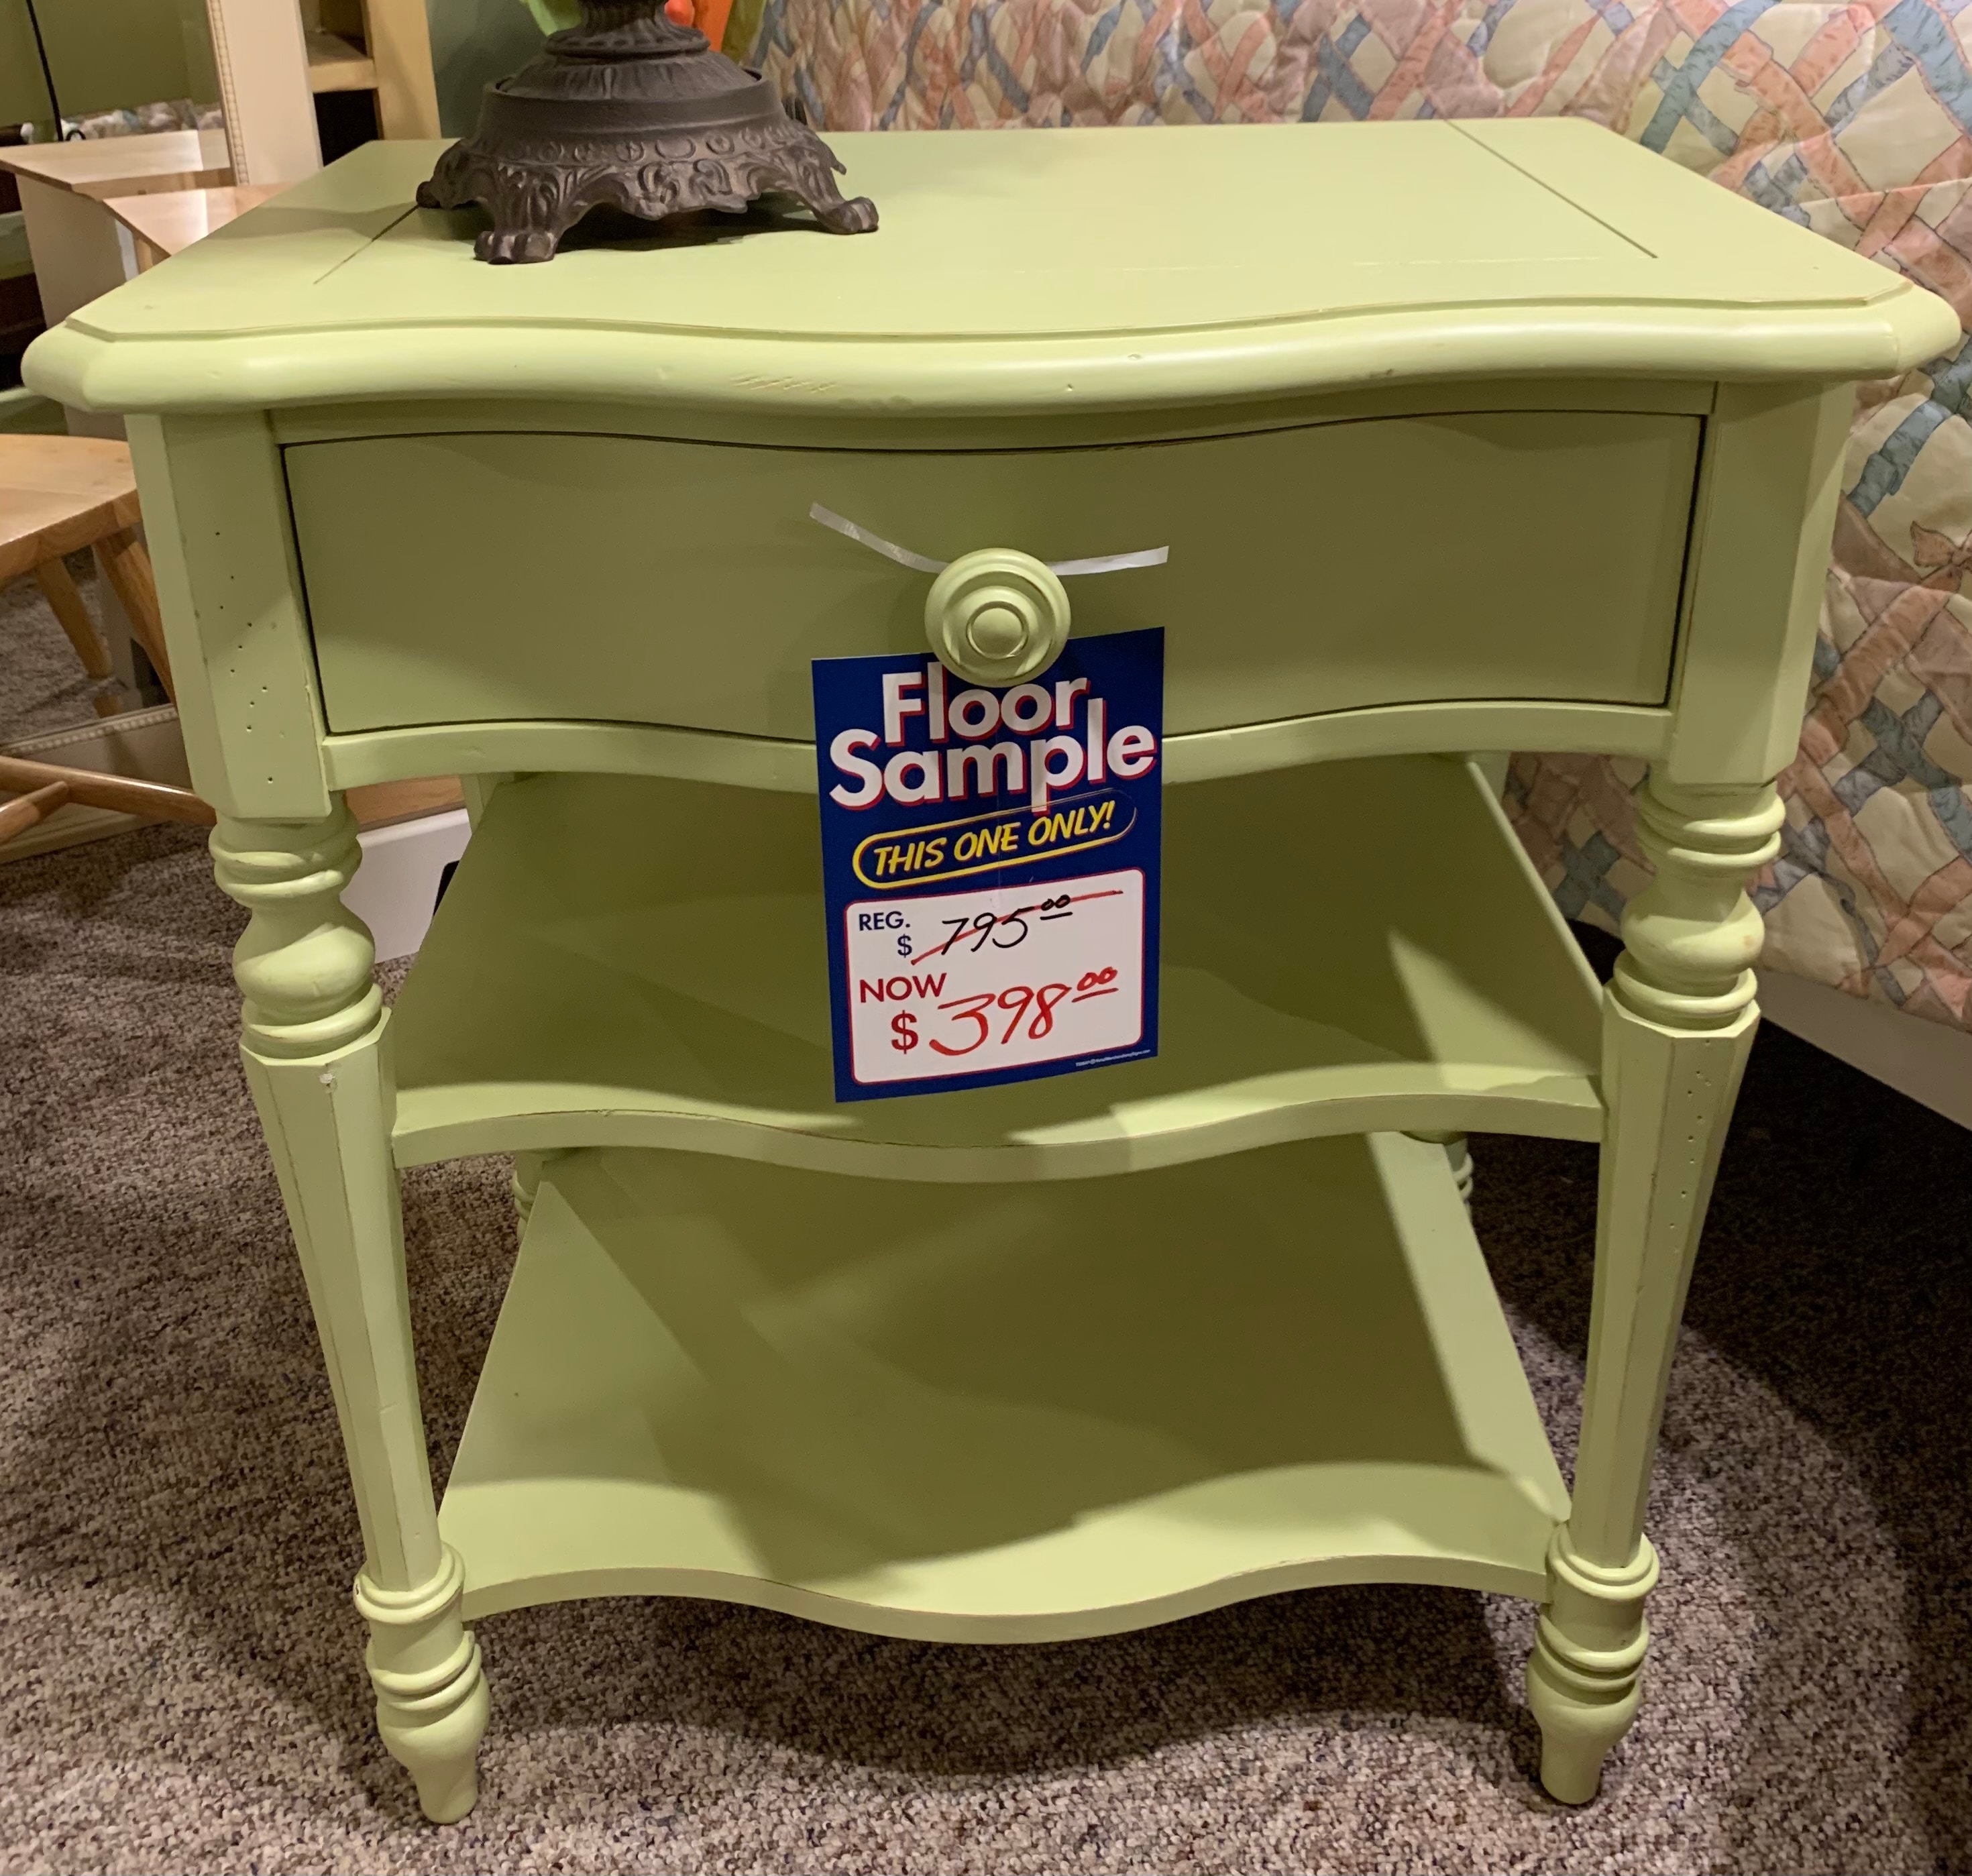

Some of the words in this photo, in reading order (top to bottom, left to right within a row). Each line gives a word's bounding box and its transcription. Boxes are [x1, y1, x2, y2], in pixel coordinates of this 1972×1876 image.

[882, 661, 1090, 745] Floor
[830, 698, 1156, 814] Sample
[873, 836, 947, 876] THIS
[954, 822, 1022, 861] ONE
[1028, 800, 1115, 842] ONLY!
[859, 911, 911, 932] REG.
[897, 934, 913, 958] $
[859, 973, 947, 1003] NOW
[891, 1010, 918, 1054] $
